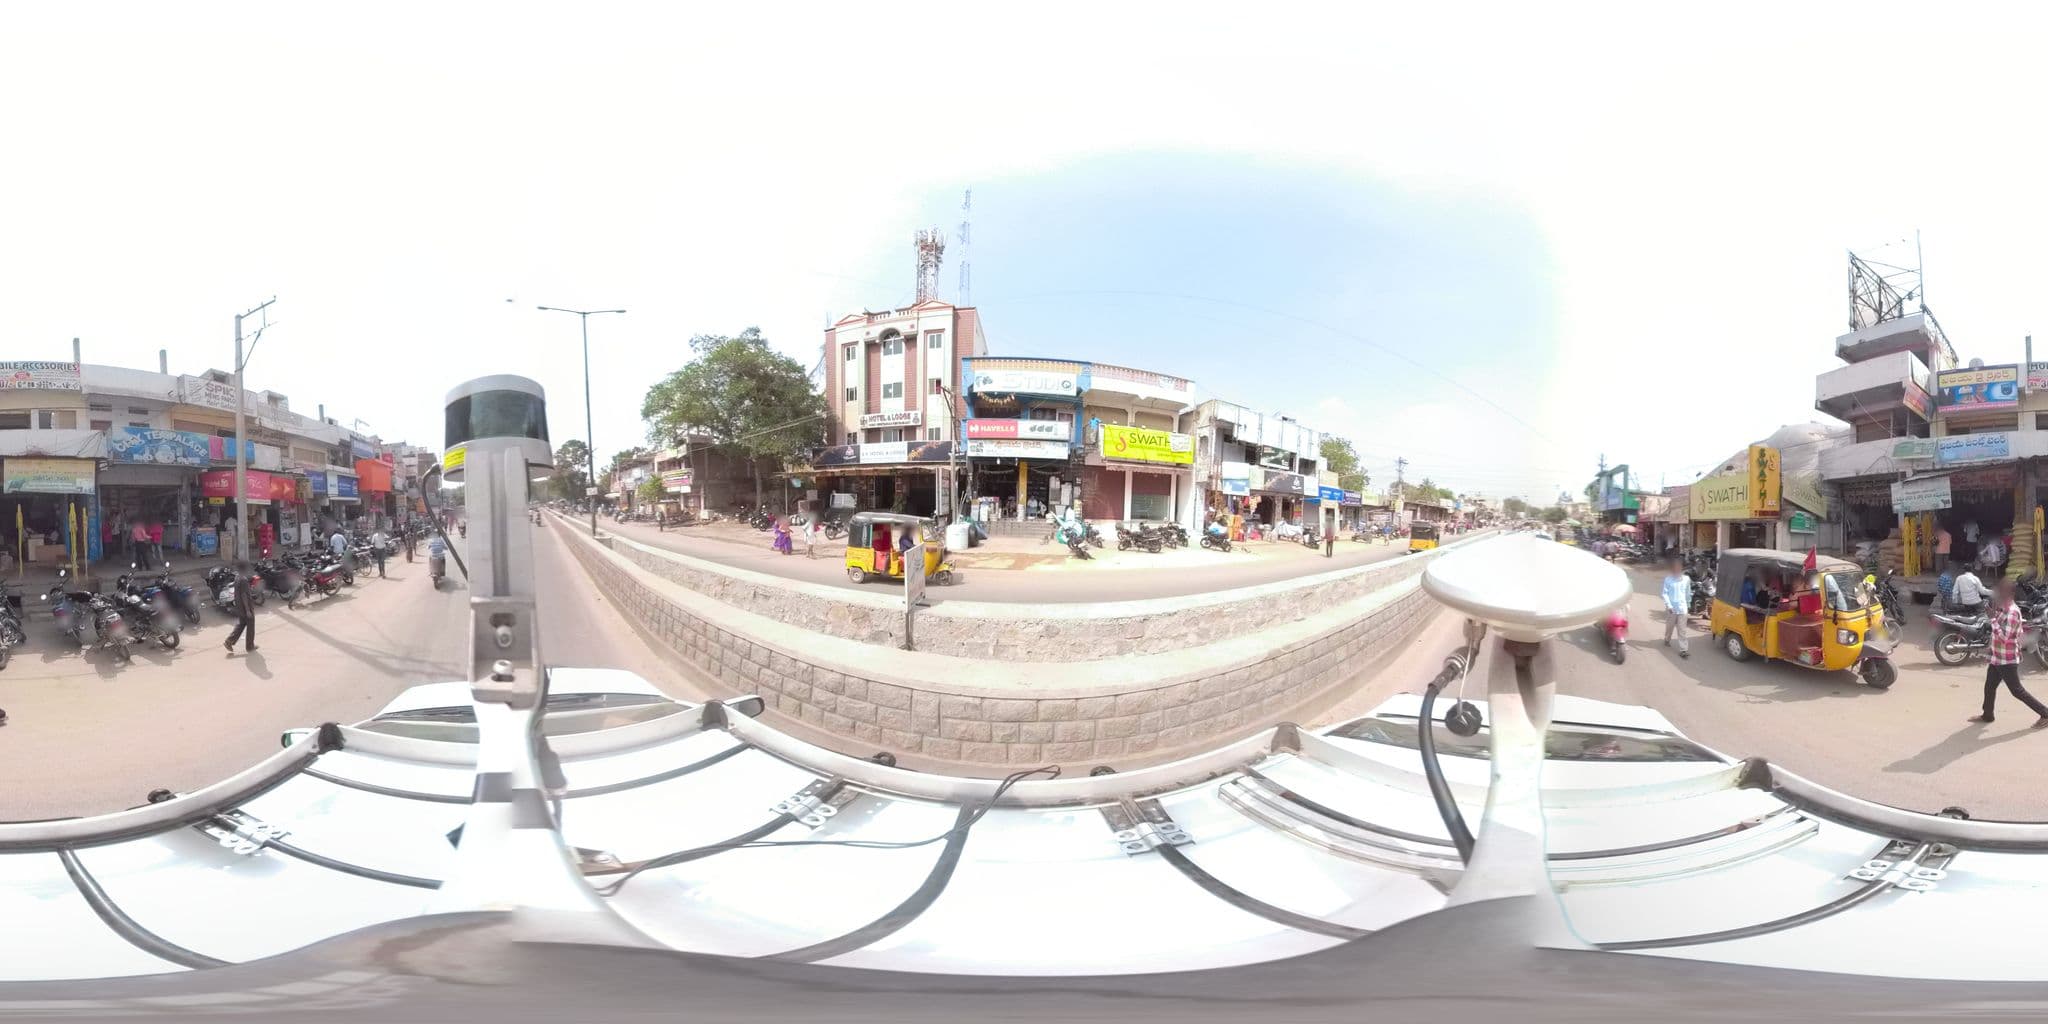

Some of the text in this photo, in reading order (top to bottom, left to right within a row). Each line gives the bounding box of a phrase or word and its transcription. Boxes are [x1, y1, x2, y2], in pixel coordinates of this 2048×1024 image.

[1129, 432, 1171, 447] SWATH
[1757, 448, 1768, 509] SWATHI
[1707, 485, 1748, 504] SWATHI
